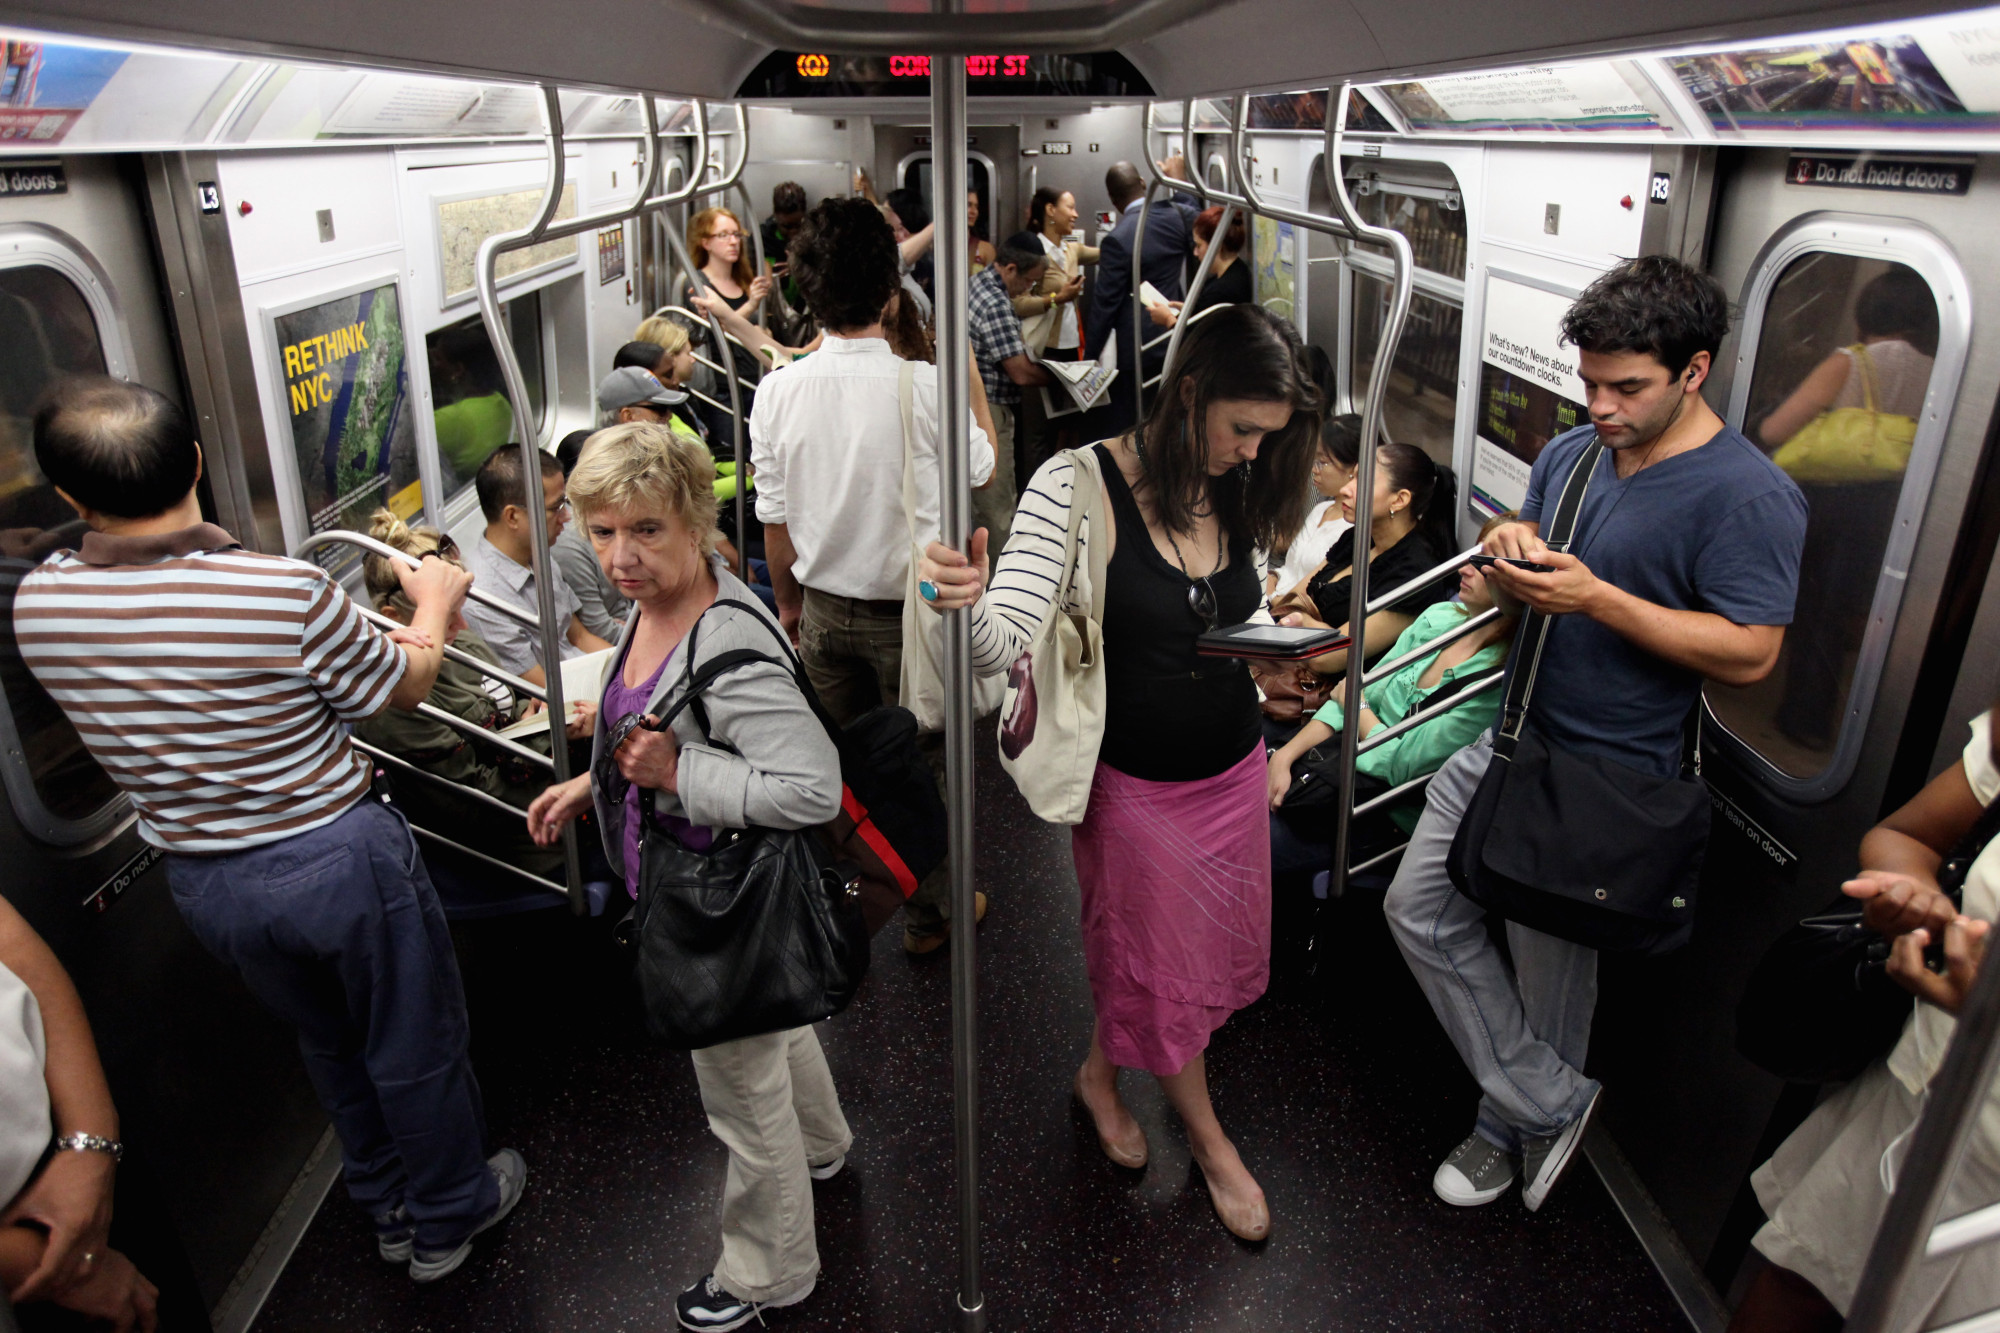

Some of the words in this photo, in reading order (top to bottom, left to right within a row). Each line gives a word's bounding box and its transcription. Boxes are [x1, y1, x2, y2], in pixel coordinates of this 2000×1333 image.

[889, 55, 1000, 76] CORNDT
[1003, 55, 1030, 76] ST
[11, 171, 57, 192] doors
[1651, 177, 1669, 200] R3
[1815, 163, 1836, 182] Do
[1838, 165, 1864, 184] not
[1866, 165, 1900, 186] hold
[1905, 168, 1958, 190] doors
[200, 187, 220, 210] L3
[284, 321, 369, 379] RETHINK
[1488, 347, 1499, 359] our
[1499, 351, 1536, 375] countdown
[1537, 367, 1563, 387] clocks.
[1489, 332, 1510, 351] What's
[1511, 343, 1529, 357] new?
[1530, 348, 1550, 366] News
[1551, 358, 1573, 377] about
[290, 372, 333, 416] NYC
[1725, 805, 1745, 831] lean
[1746, 827, 1760, 844] on
[1761, 840, 1787, 866] door
[113, 875, 130, 894] Do
[131, 856, 150, 878] not
[150, 847, 164, 861] le
